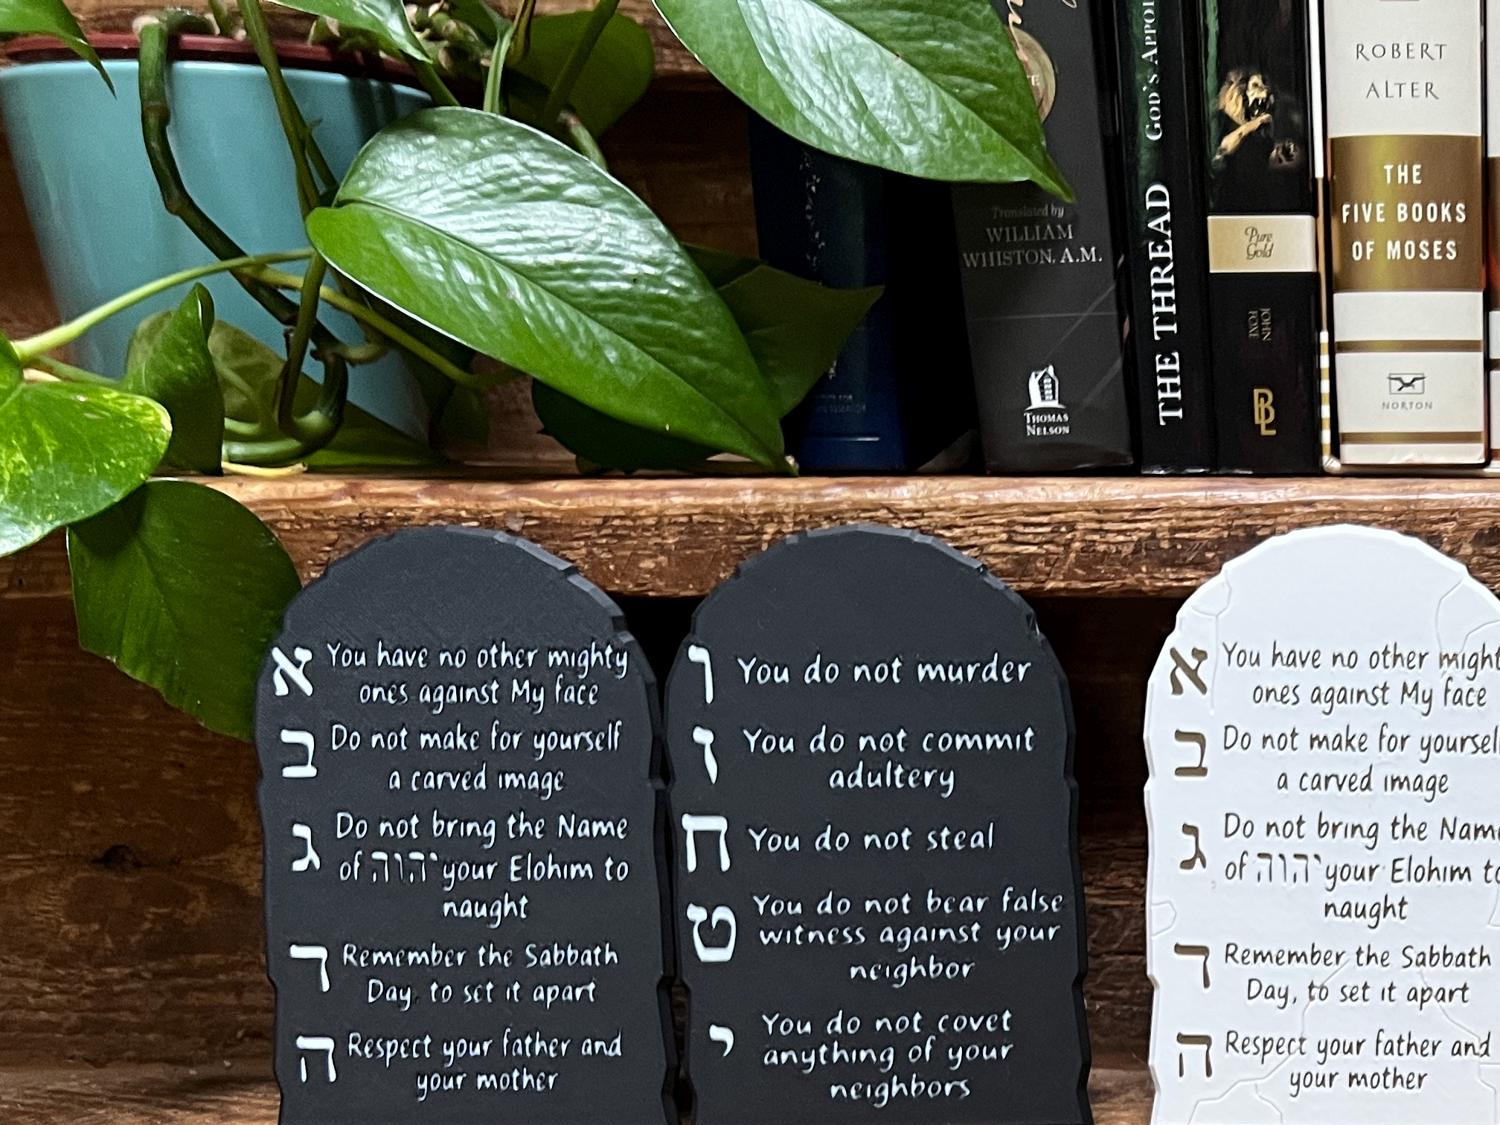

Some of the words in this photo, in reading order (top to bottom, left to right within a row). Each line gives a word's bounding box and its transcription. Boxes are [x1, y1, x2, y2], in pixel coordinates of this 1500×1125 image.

[1355, 42, 1448, 61] ROBERT
[1366, 80, 1440, 100] ALTER
[1383, 164, 1421, 185] THE
[1051, 202, 1064, 218] by
[1342, 203, 1386, 224] FIVE
[1396, 202, 1467, 223] BOOKS
[986, 224, 1073, 243] WILLIAM
[1245, 226, 1273, 243] Pure
[1351, 241, 1376, 261] OF
[1386, 240, 1457, 260] MOSES
[1060, 246, 1103, 264] A.M.
[1145, 183, 1178, 341] THREAD
[1246, 243, 1274, 260] Gold
[1259, 307, 1272, 341] JOHN
[1155, 351, 1183, 426] THE
[1381, 401, 1433, 410] NORTON
[1024, 412, 1069, 424] THOMAS
[1026, 424, 1070, 437] NELSON
[272, 647, 312, 696] א
[327, 643, 365, 666] You
[378, 641, 427, 667] have
[440, 650, 466, 668] no
[478, 641, 537, 668] other
[549, 642, 627, 679] mighty
[360, 684, 407, 704] ones
[420, 680, 499, 714] against
[512, 679, 544, 713] My
[556, 674, 597, 704] face
[281, 730, 317, 777] ב
[332, 725, 360, 750] Do
[372, 728, 407, 750] not
[421, 723, 479, 750] make
[492, 720, 522, 750] for
[534, 721, 622, 760] yourself
[693, 727, 717, 784] ז
[744, 729, 793, 753] You
[810, 725, 844, 752] do
[859, 729, 906, 752] not
[923, 728, 1033, 752] commit
[390, 771, 400, 789] a
[412, 763, 486, 791] carved
[499, 772, 563, 800] image
[830, 761, 953, 797] adultery
[337, 813, 367, 838] Do
[380, 815, 418, 838] not
[433, 810, 495, 848] bring
[508, 812, 544, 838] the
[559, 814, 627, 839] Name
[293, 824, 320, 871] ג
[340, 851, 362, 880] of
[444, 862, 497, 891] your
[511, 853, 593, 881] Elohim
[605, 857, 628, 880] to
[444, 893, 528, 928] naught
[1174, 943, 1210, 988] ד
[1225, 943, 1345, 966] Remember
[1356, 944, 1389, 967] the
[1402, 945, 1491, 968] Sabbath
[1248, 978, 1296, 1009] Day,
[1308, 980, 1328, 1001] to
[1340, 982, 1370, 1002] set
[1382, 982, 1396, 1002] it
[1407, 983, 1469, 1010] apart
[1177, 1032, 1212, 1077] ה
[1226, 1030, 1306, 1064] Respect
[1318, 1039, 1366, 1065] your
[1376, 1029, 1441, 1057] father
[1451, 1032, 1490, 1057] and
[1290, 1072, 1339, 1097] your
[1349, 1067, 1427, 1089] mother
